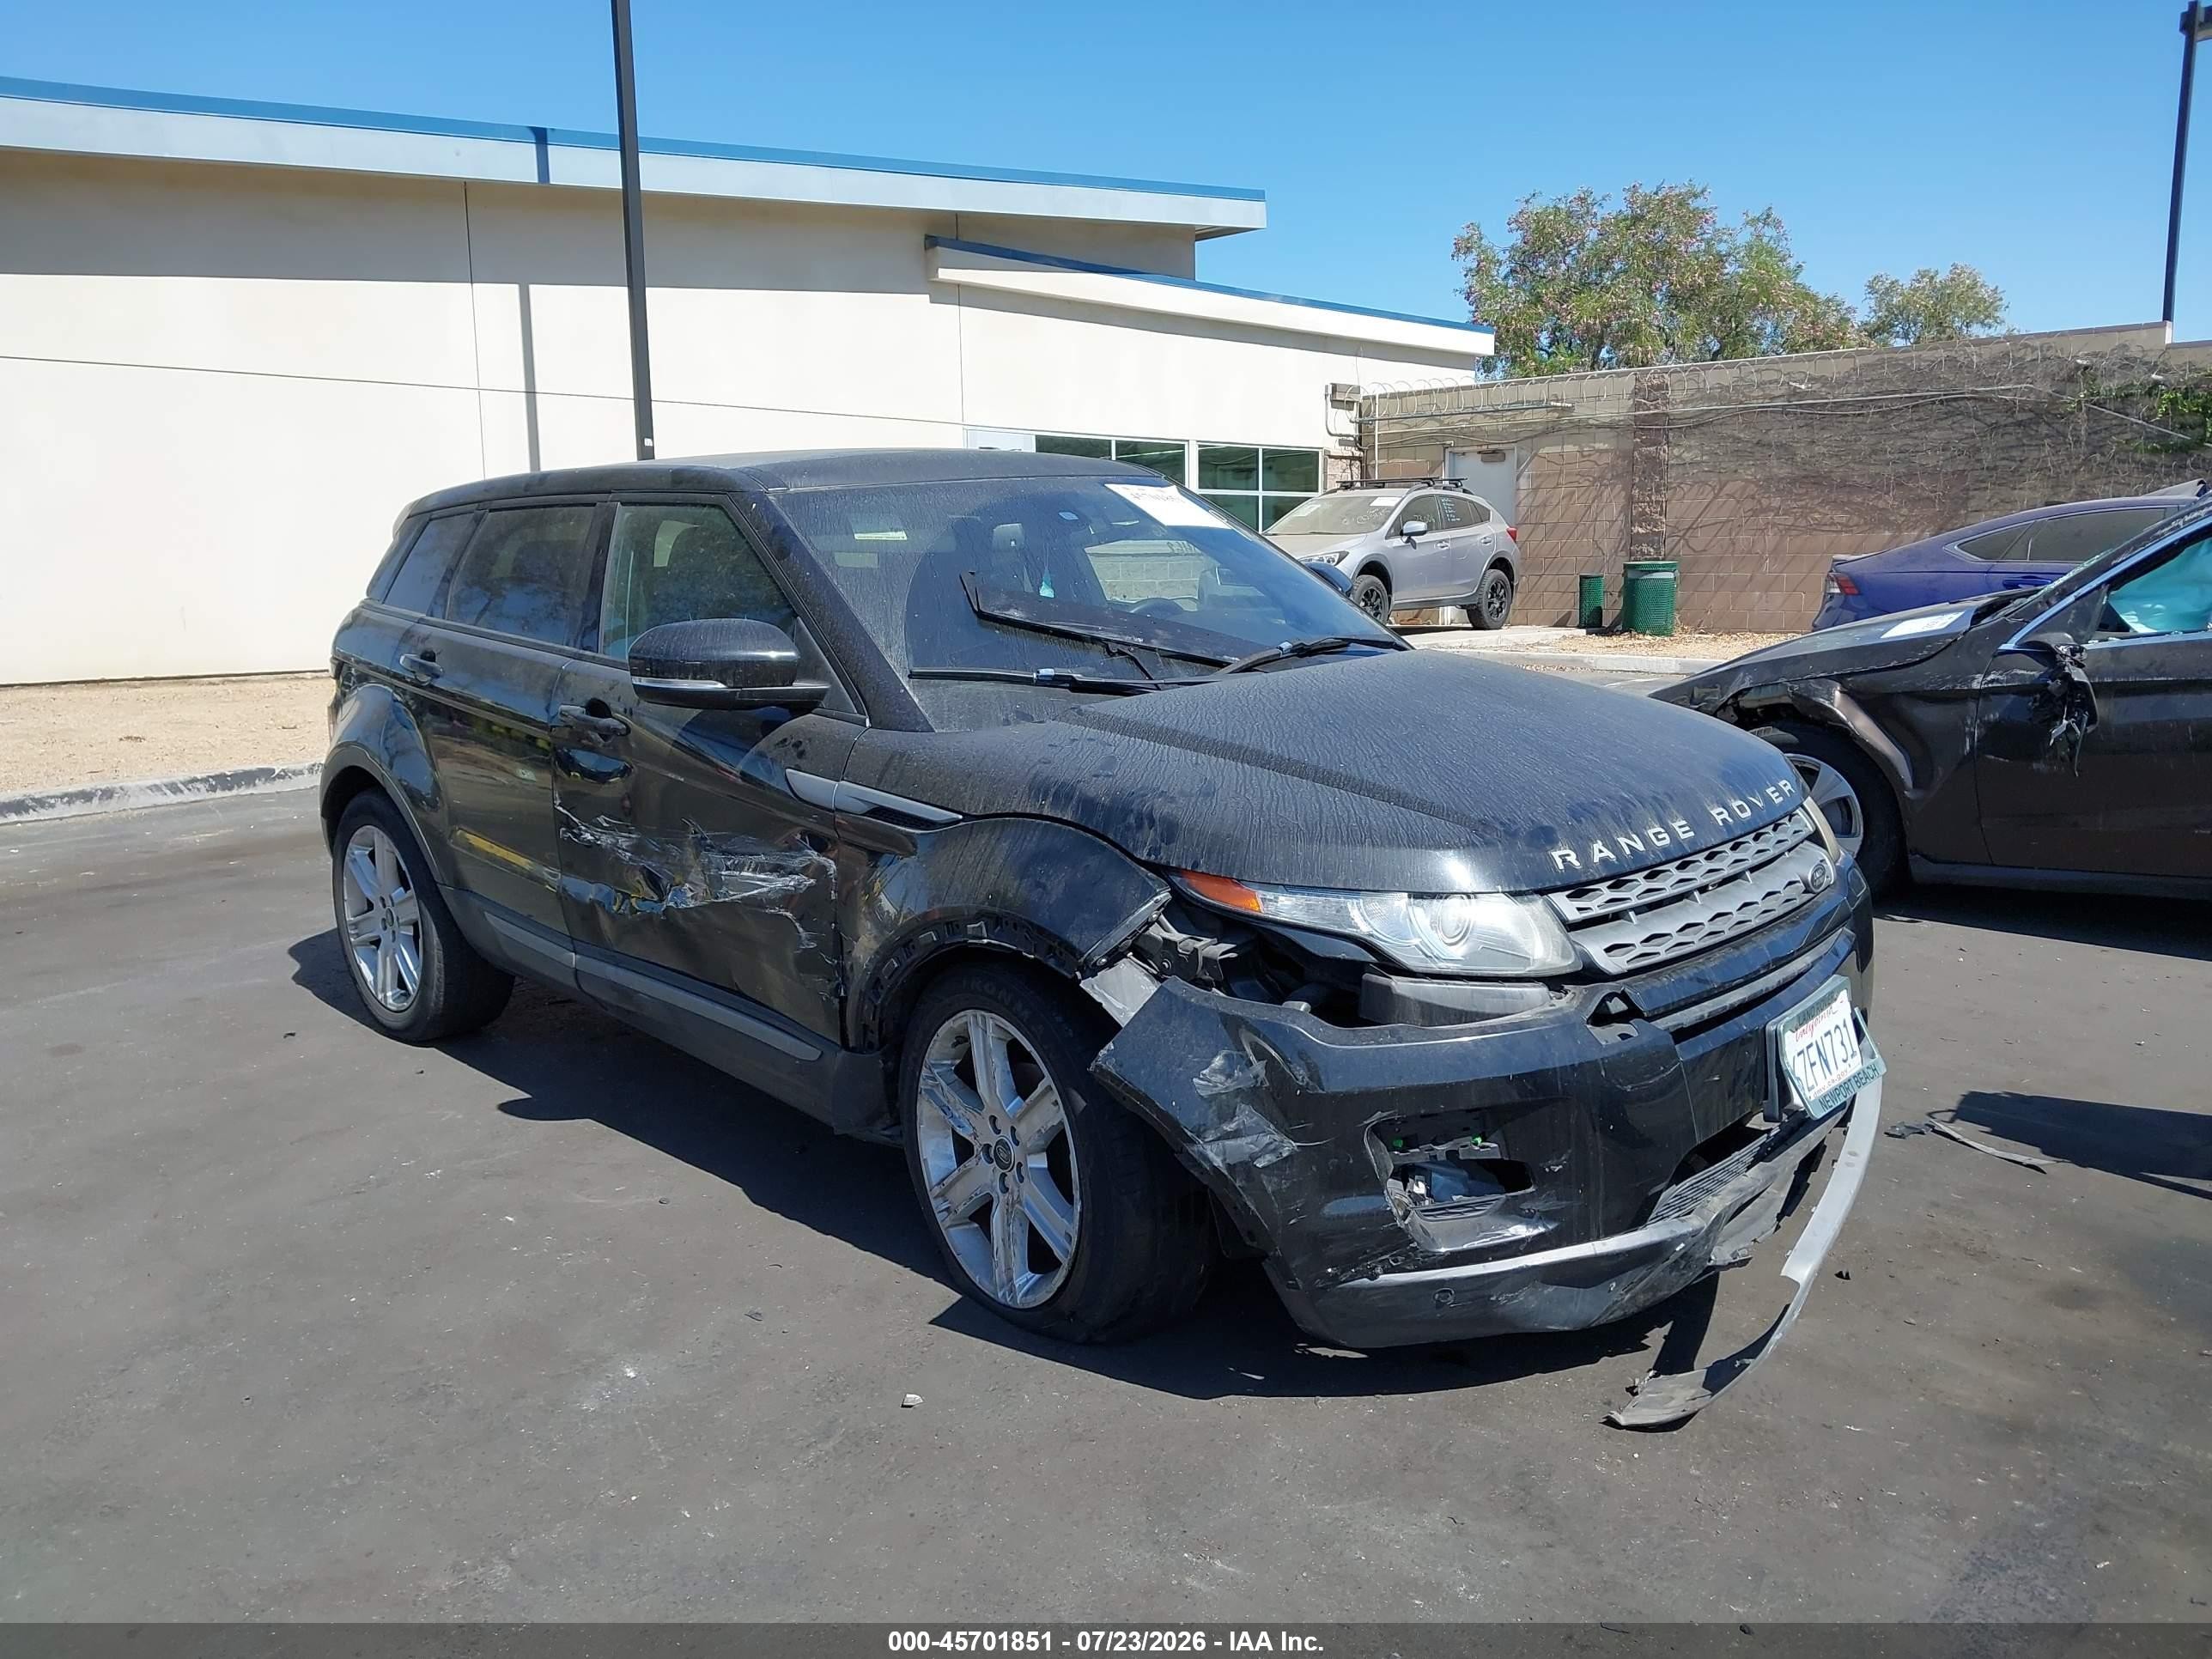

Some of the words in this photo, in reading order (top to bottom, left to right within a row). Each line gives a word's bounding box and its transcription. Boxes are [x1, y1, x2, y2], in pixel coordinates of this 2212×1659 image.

[1551, 819, 1695, 871] RANGE
[1710, 778, 1796, 827] ROVER
[1819, 1079, 1856, 1111] NEWPORT
[1854, 1063, 1880, 1090] BEACH
